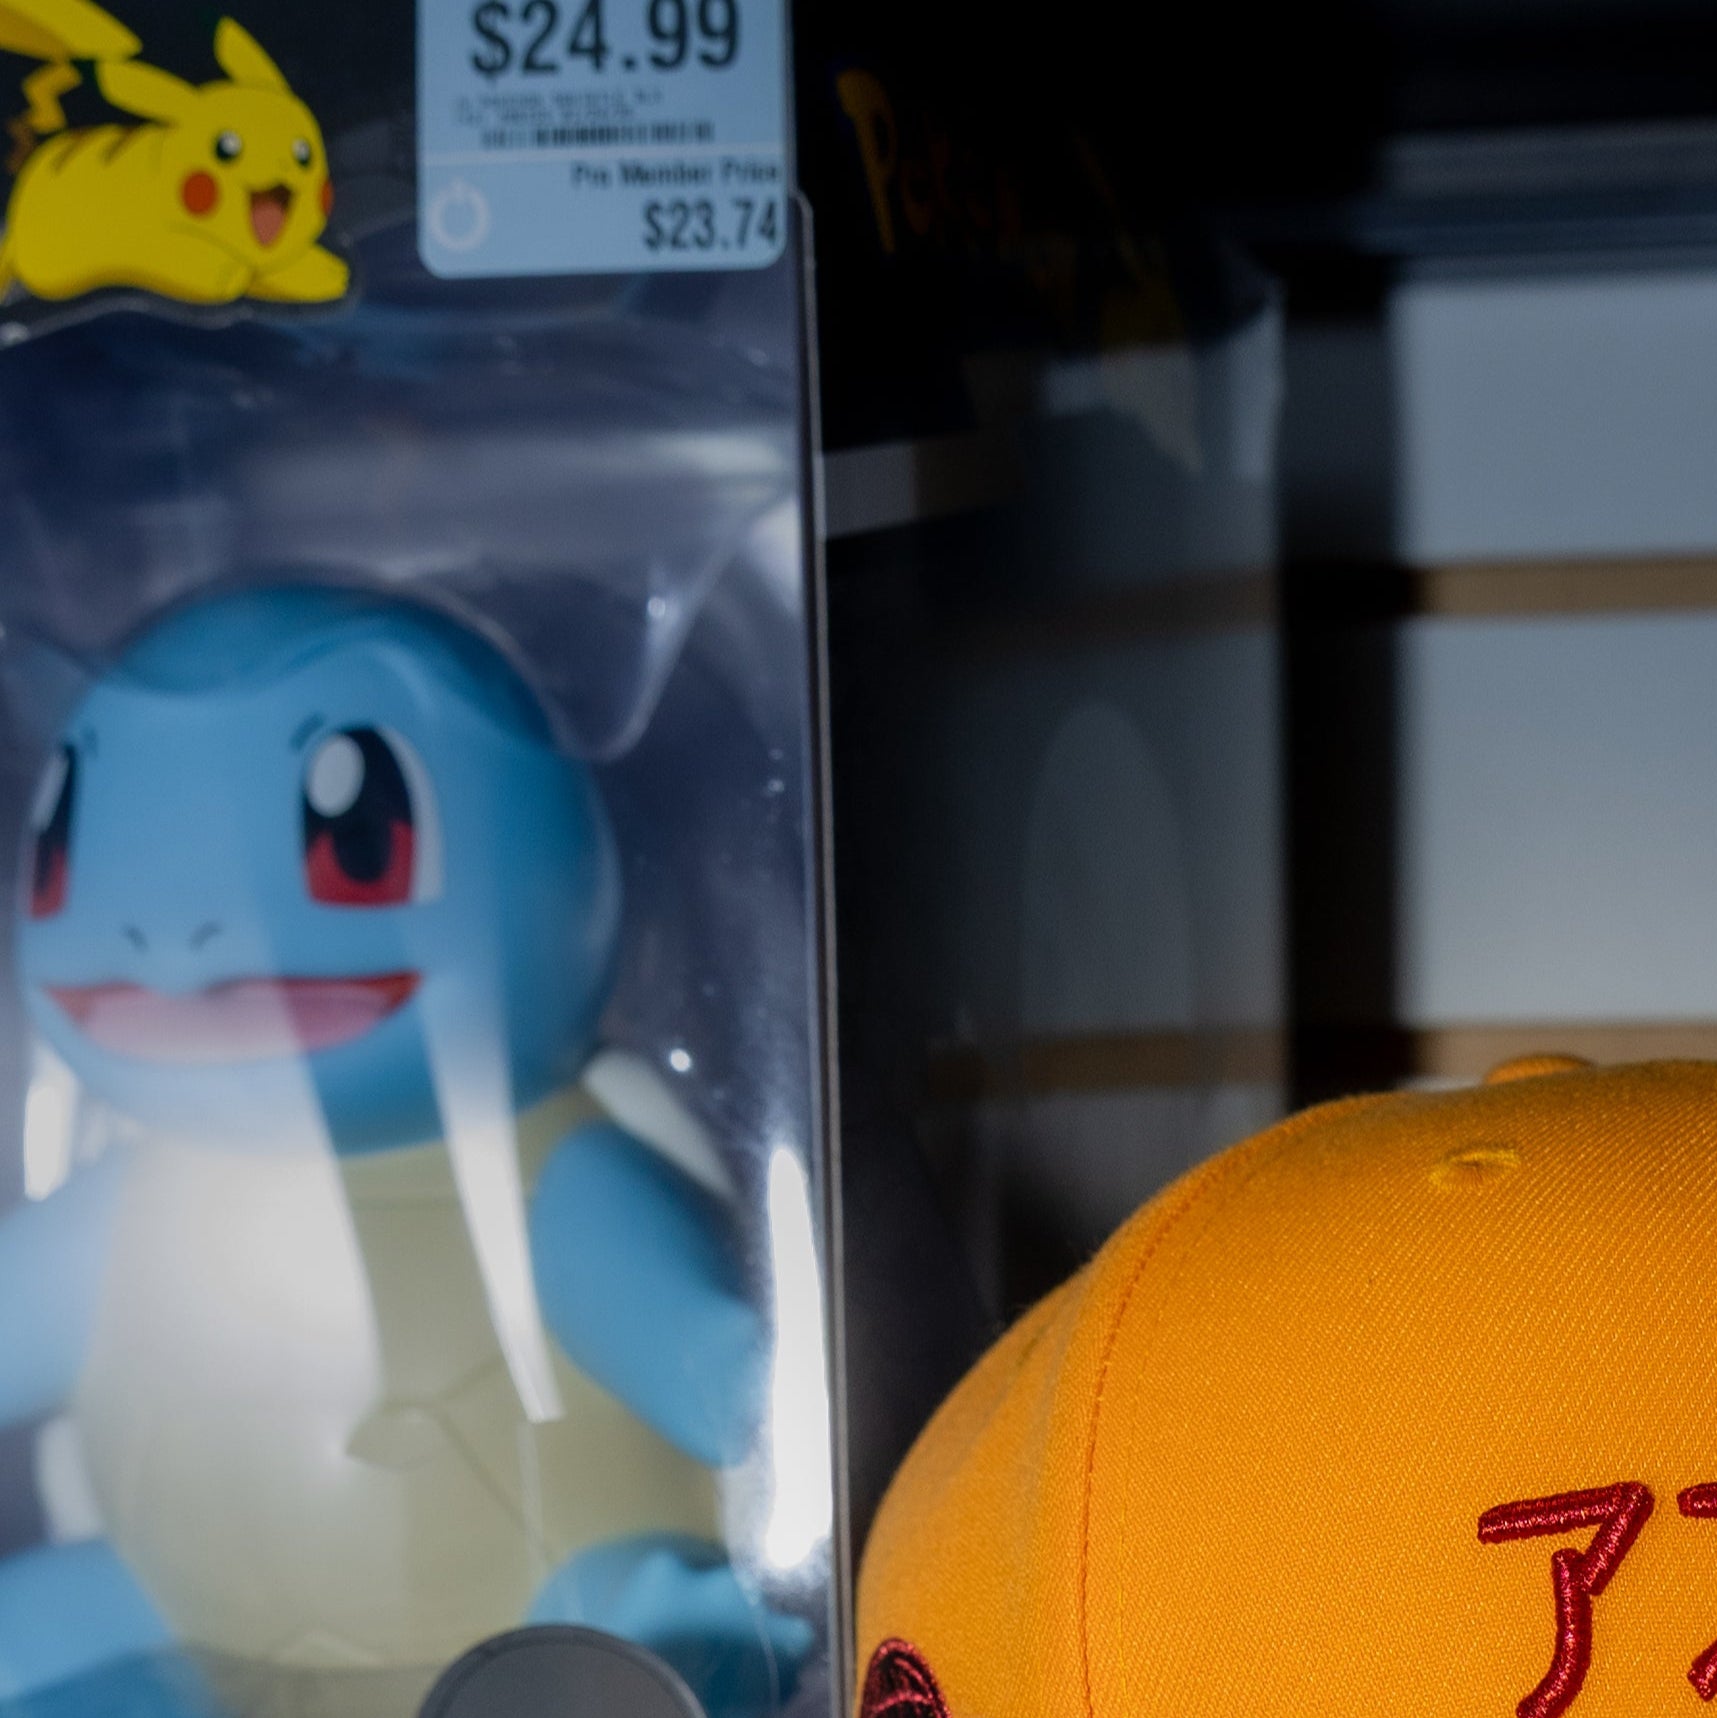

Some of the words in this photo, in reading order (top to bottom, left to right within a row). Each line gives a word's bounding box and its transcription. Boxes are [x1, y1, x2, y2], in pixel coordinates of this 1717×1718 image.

[470, 0, 741, 84] $24.99
[570, 160, 613, 188] Pro
[619, 161, 716, 187] Member
[720, 156, 781, 183] Price
[644, 198, 778, 251] $23.74
